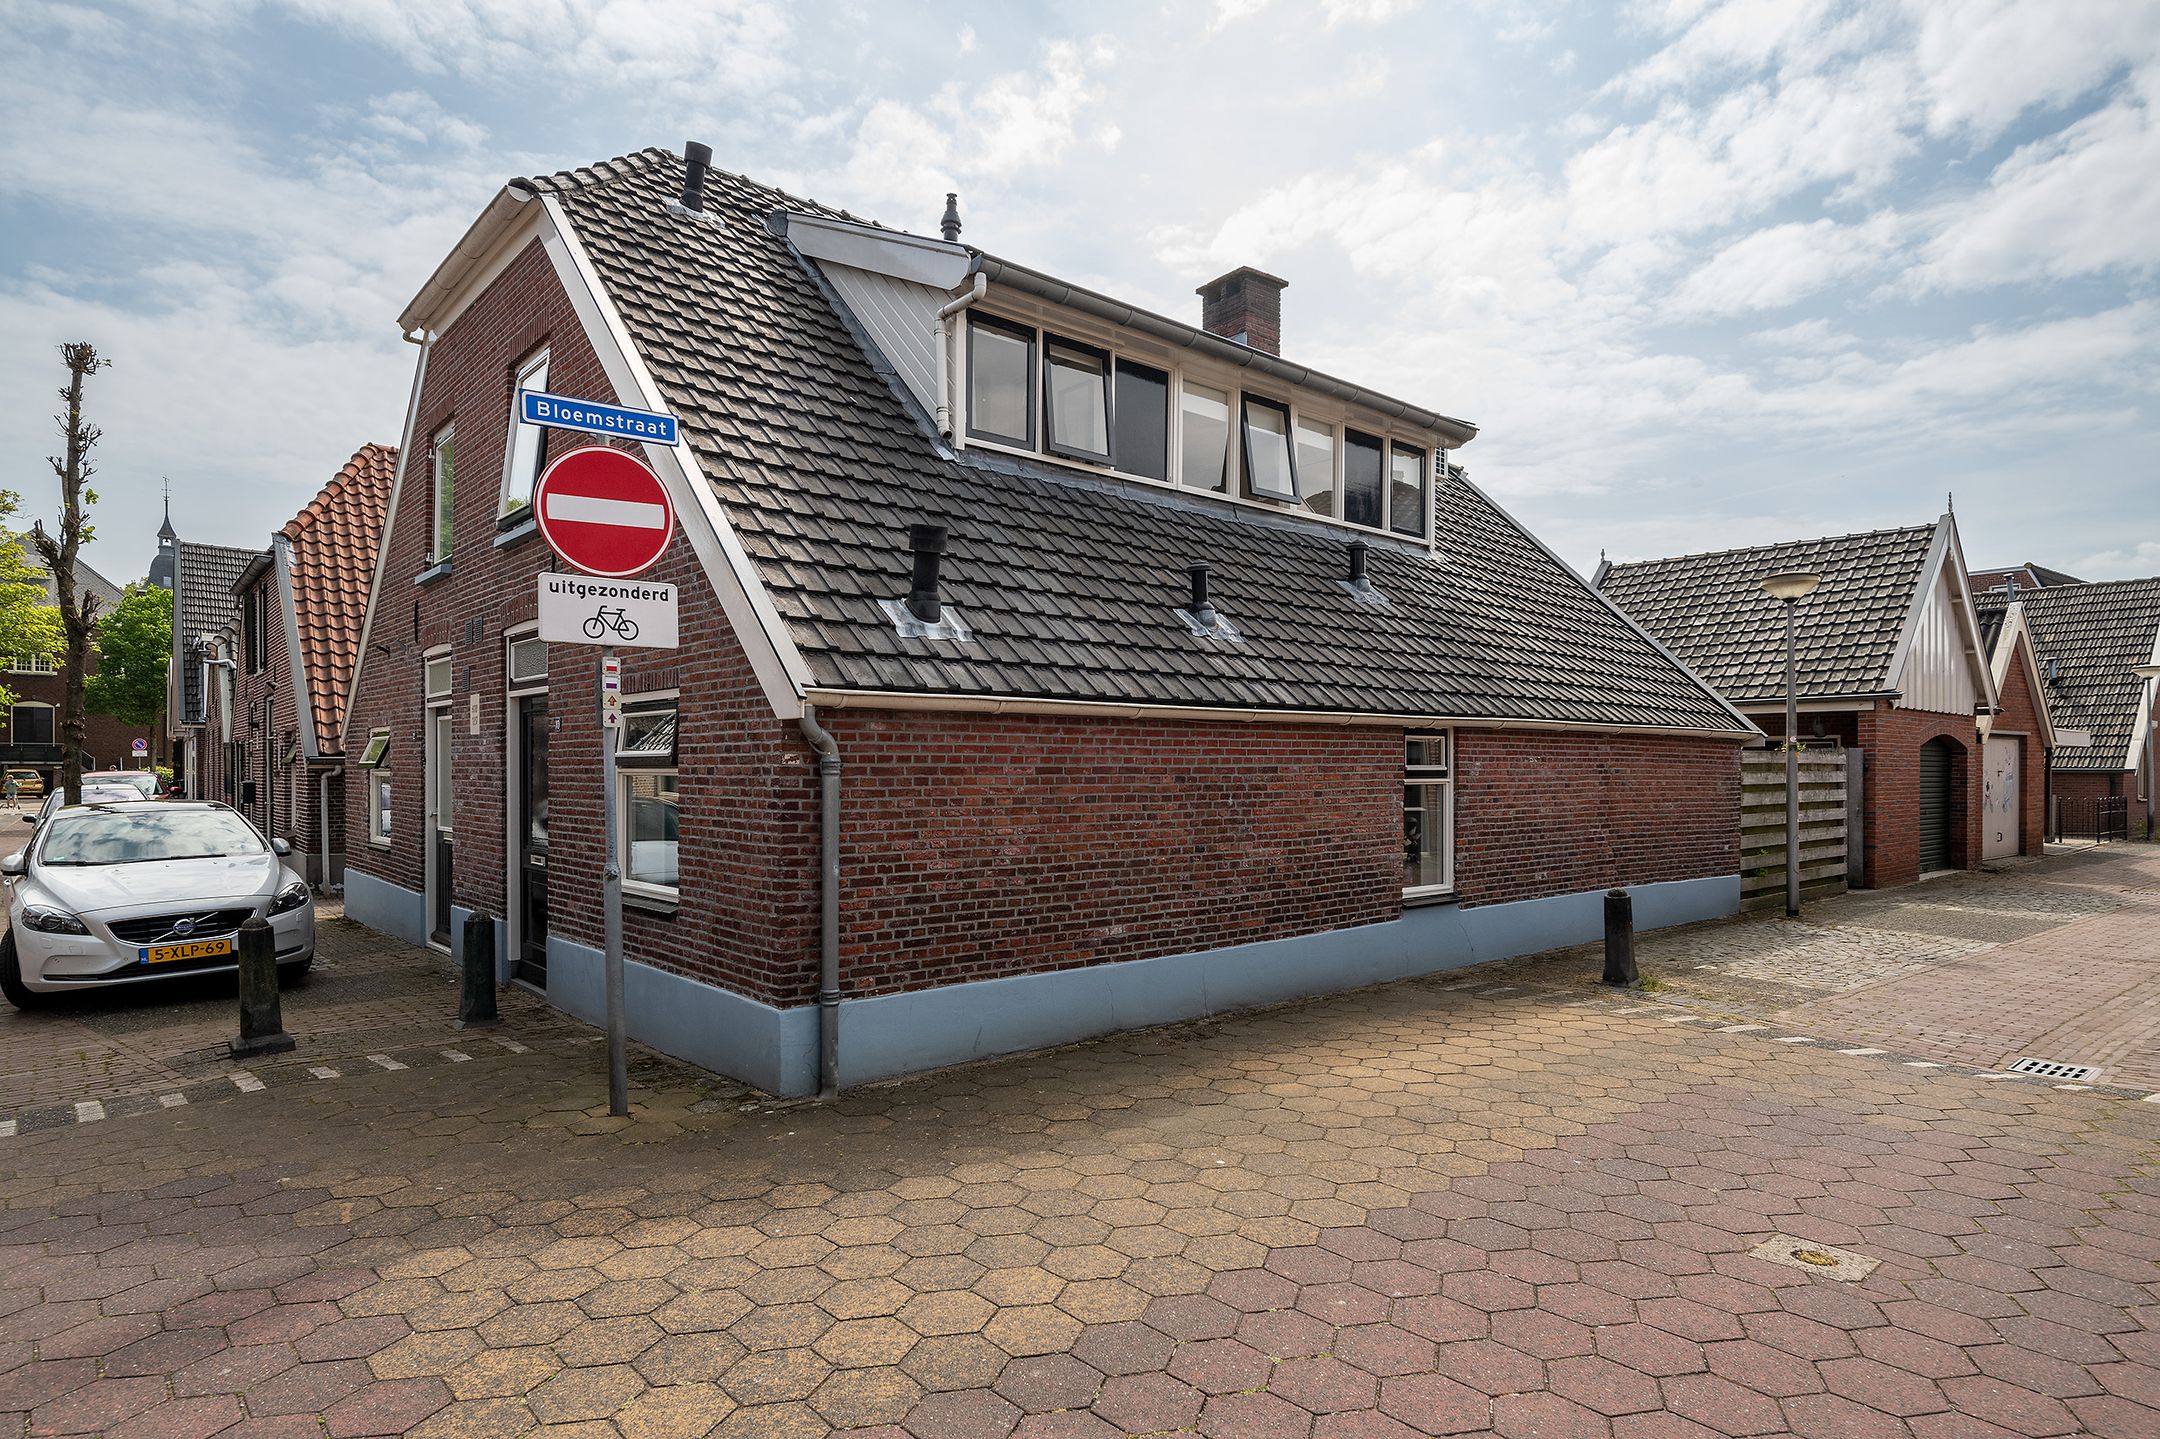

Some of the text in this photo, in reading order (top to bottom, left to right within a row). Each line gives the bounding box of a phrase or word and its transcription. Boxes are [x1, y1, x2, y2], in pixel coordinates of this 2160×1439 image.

[537, 400, 667, 436] Bloemstraat
[549, 580, 669, 601] uitgezonderd
[155, 942, 225, 960] 5-XLP-69
